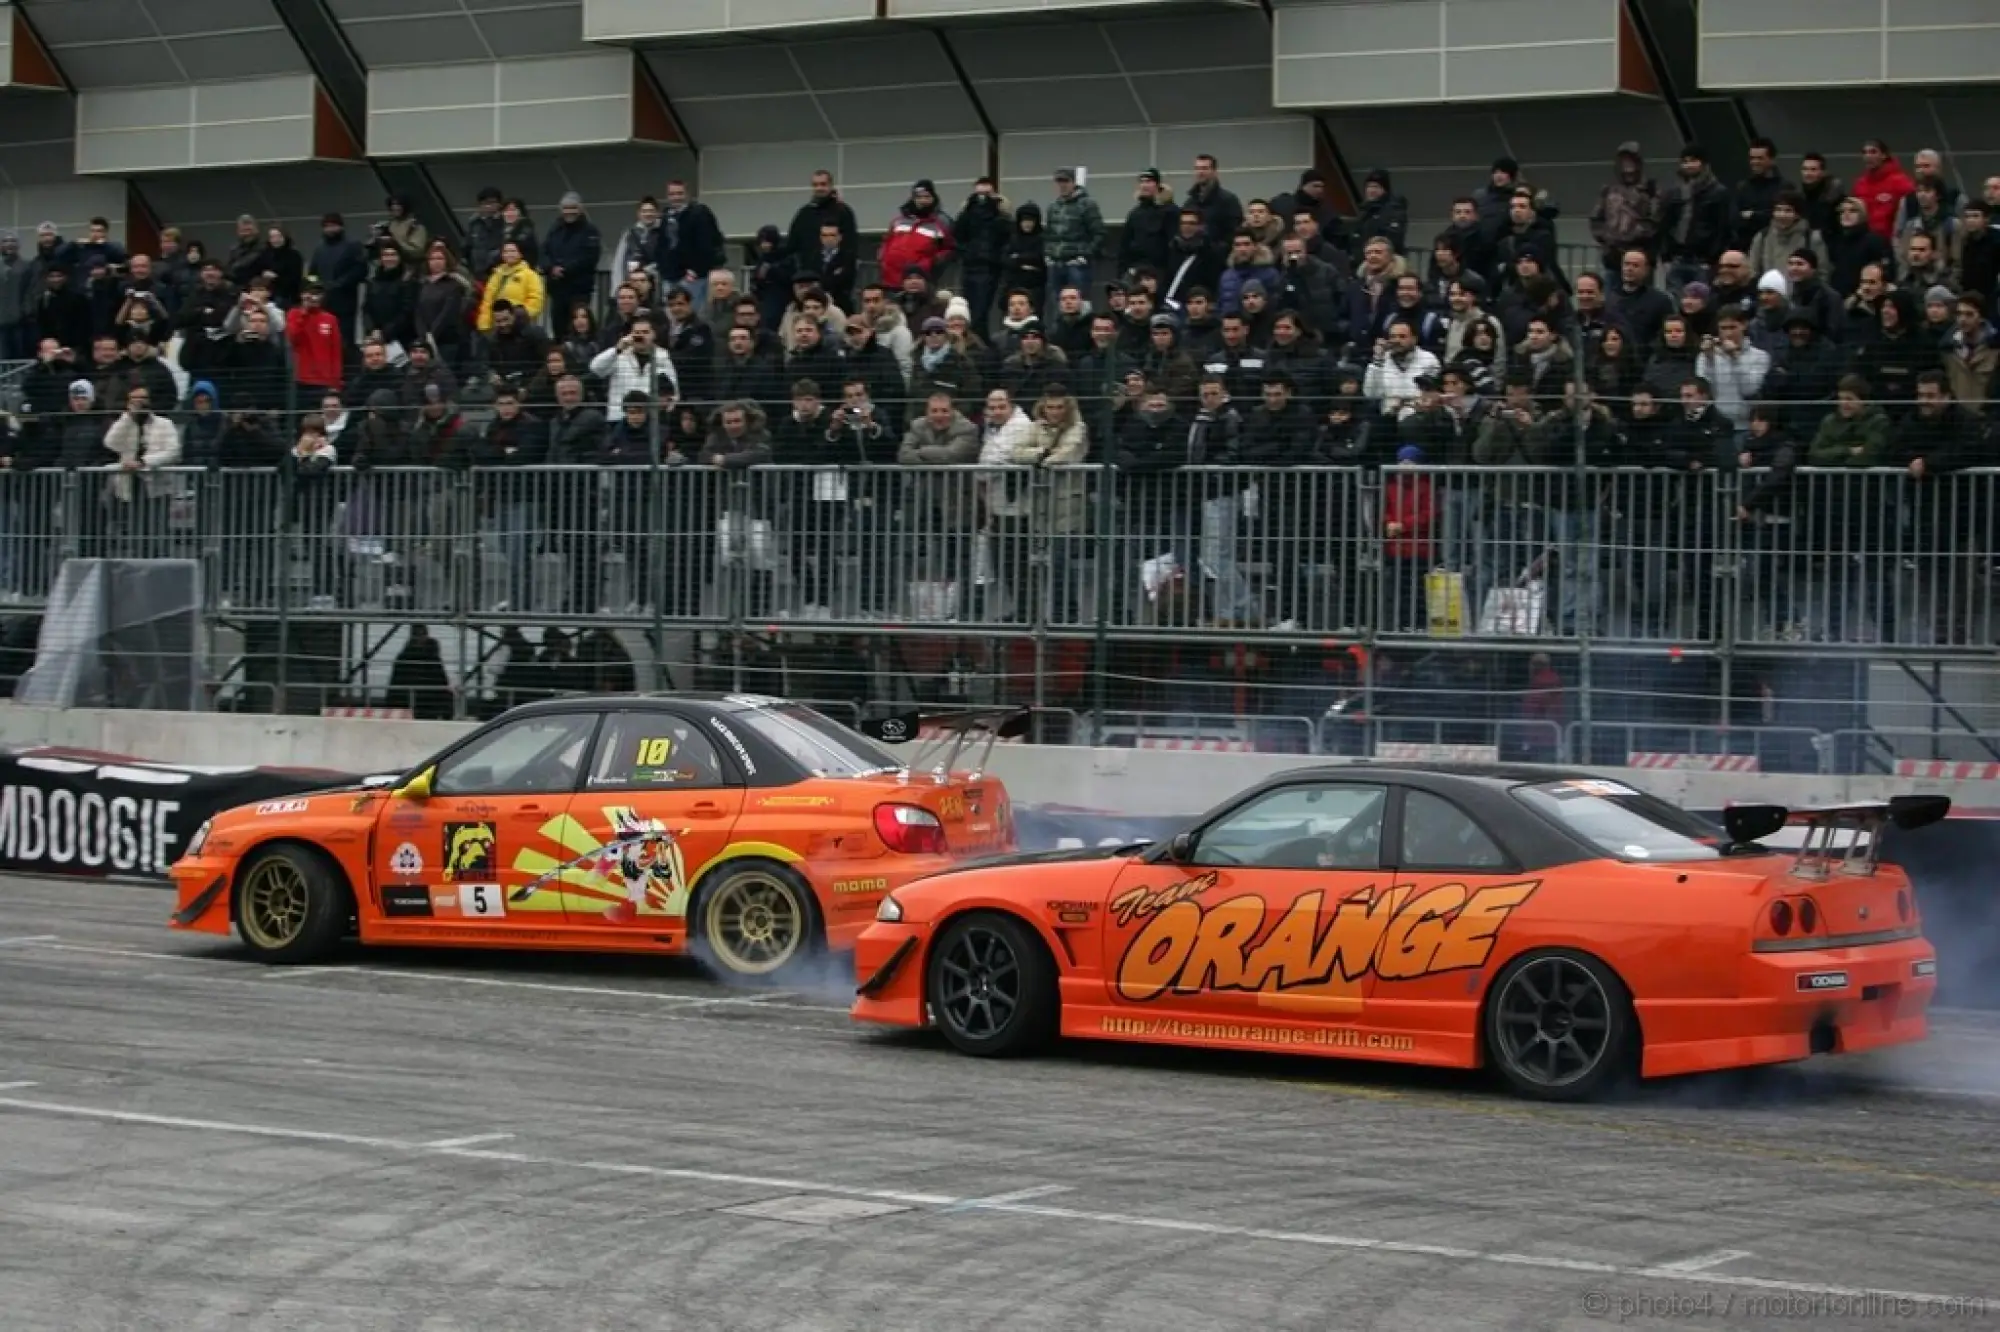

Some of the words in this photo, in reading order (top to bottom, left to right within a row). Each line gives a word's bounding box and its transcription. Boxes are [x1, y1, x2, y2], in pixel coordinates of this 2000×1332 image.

[635, 737, 671, 767] 10
[474, 886, 488, 914] 5
[833, 878, 887, 893] momo
[1110, 870, 1218, 927] Team
[1116, 879, 1543, 1001] ORANGE
[1101, 1015, 1414, 1051] http://teamorange-drift.com
